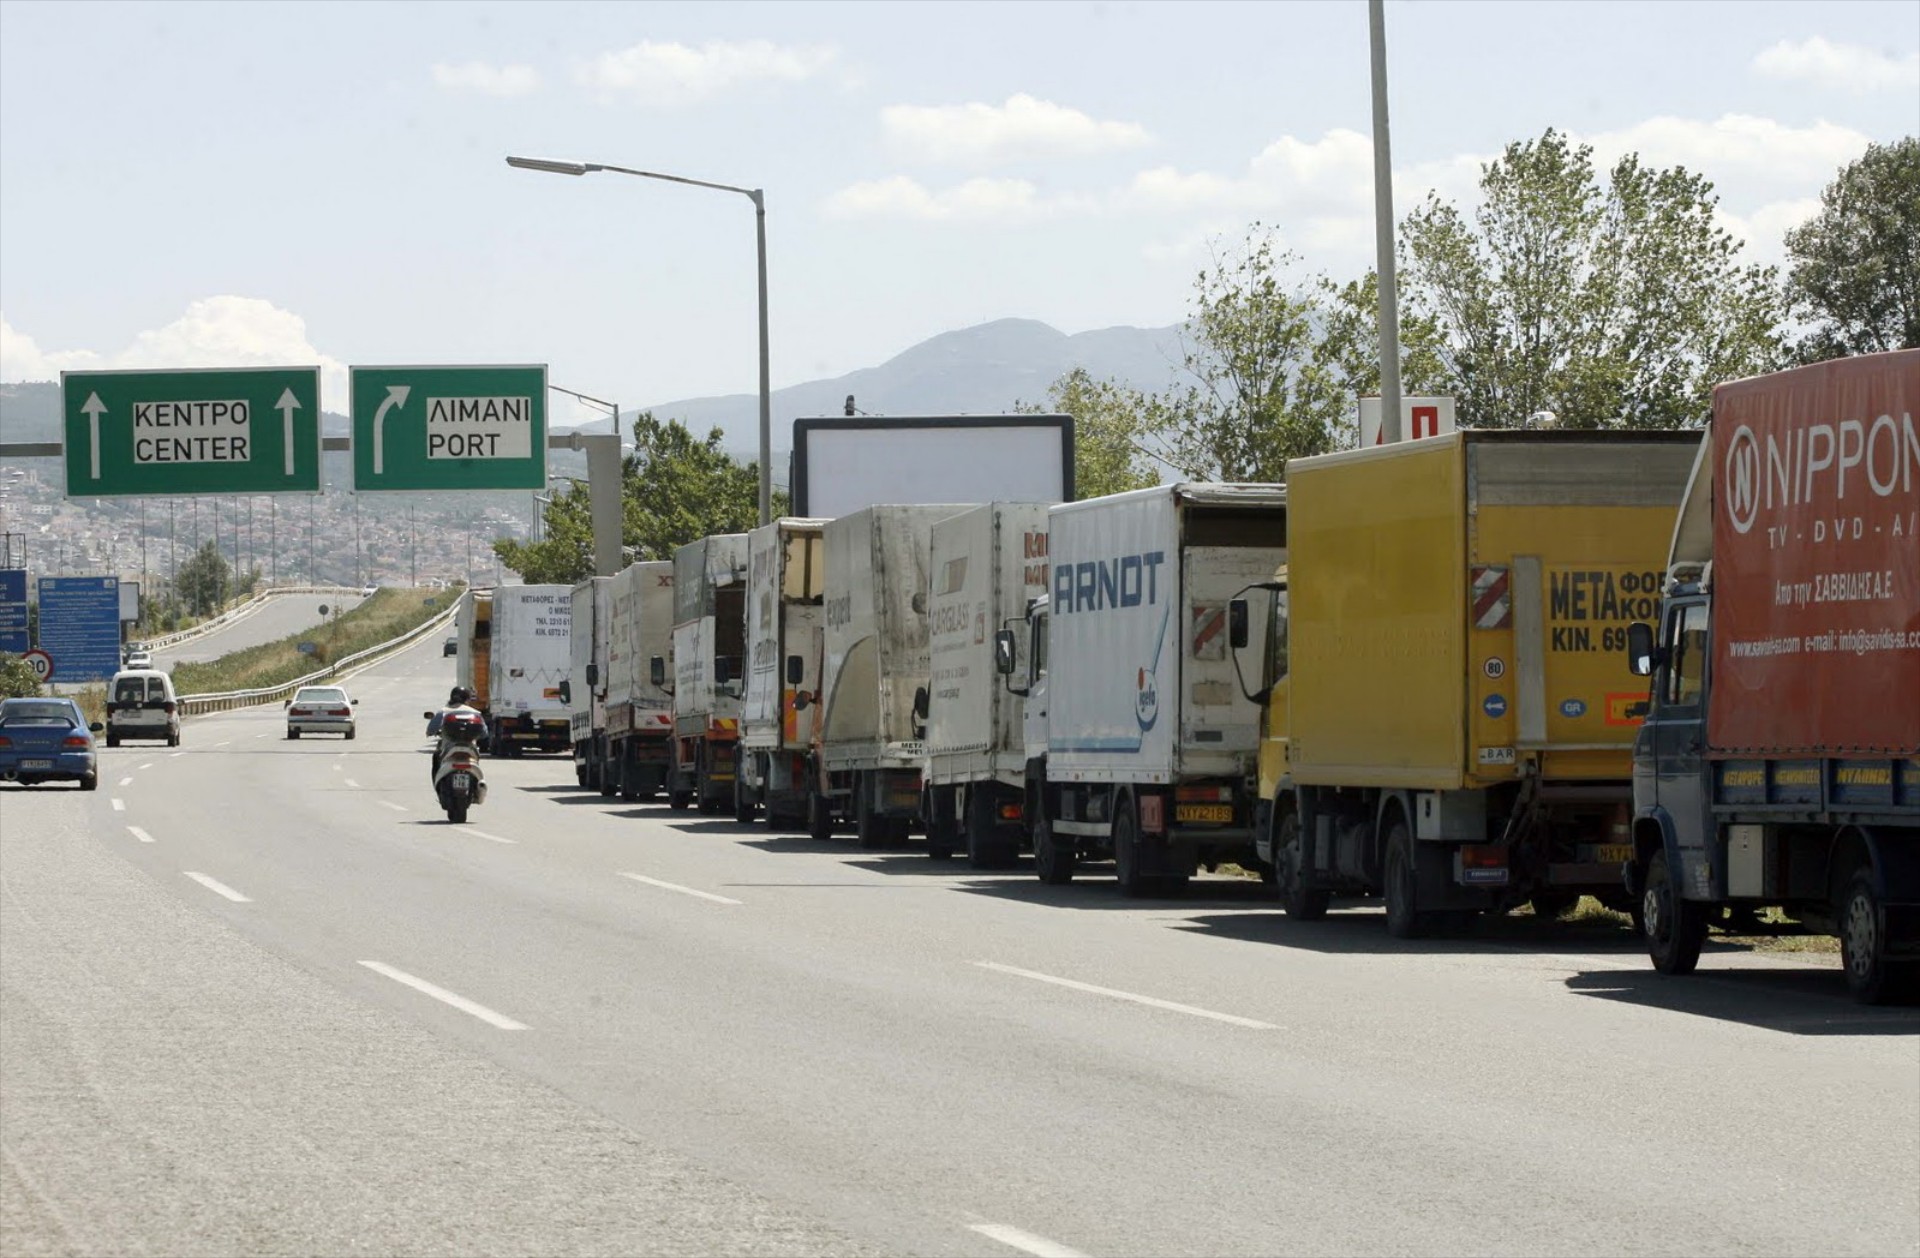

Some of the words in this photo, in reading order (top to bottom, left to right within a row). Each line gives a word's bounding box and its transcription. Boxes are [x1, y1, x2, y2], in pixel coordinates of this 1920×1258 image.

[135, 402, 247, 427] ΚΕΝΤΡΟ
[429, 398, 529, 422] ΛΙΜΑΝΙ
[136, 437, 247, 461] CENTER
[429, 433, 500, 457] PORT
[1766, 412, 1920, 510] NIPPON
[1768, 525, 1788, 549] TV
[1814, 517, 1863, 543] DVD
[1551, 571, 1619, 620] ΜΕΤΑ
[1487, 663, 1501, 674] 80
[1565, 703, 1581, 713] GR
